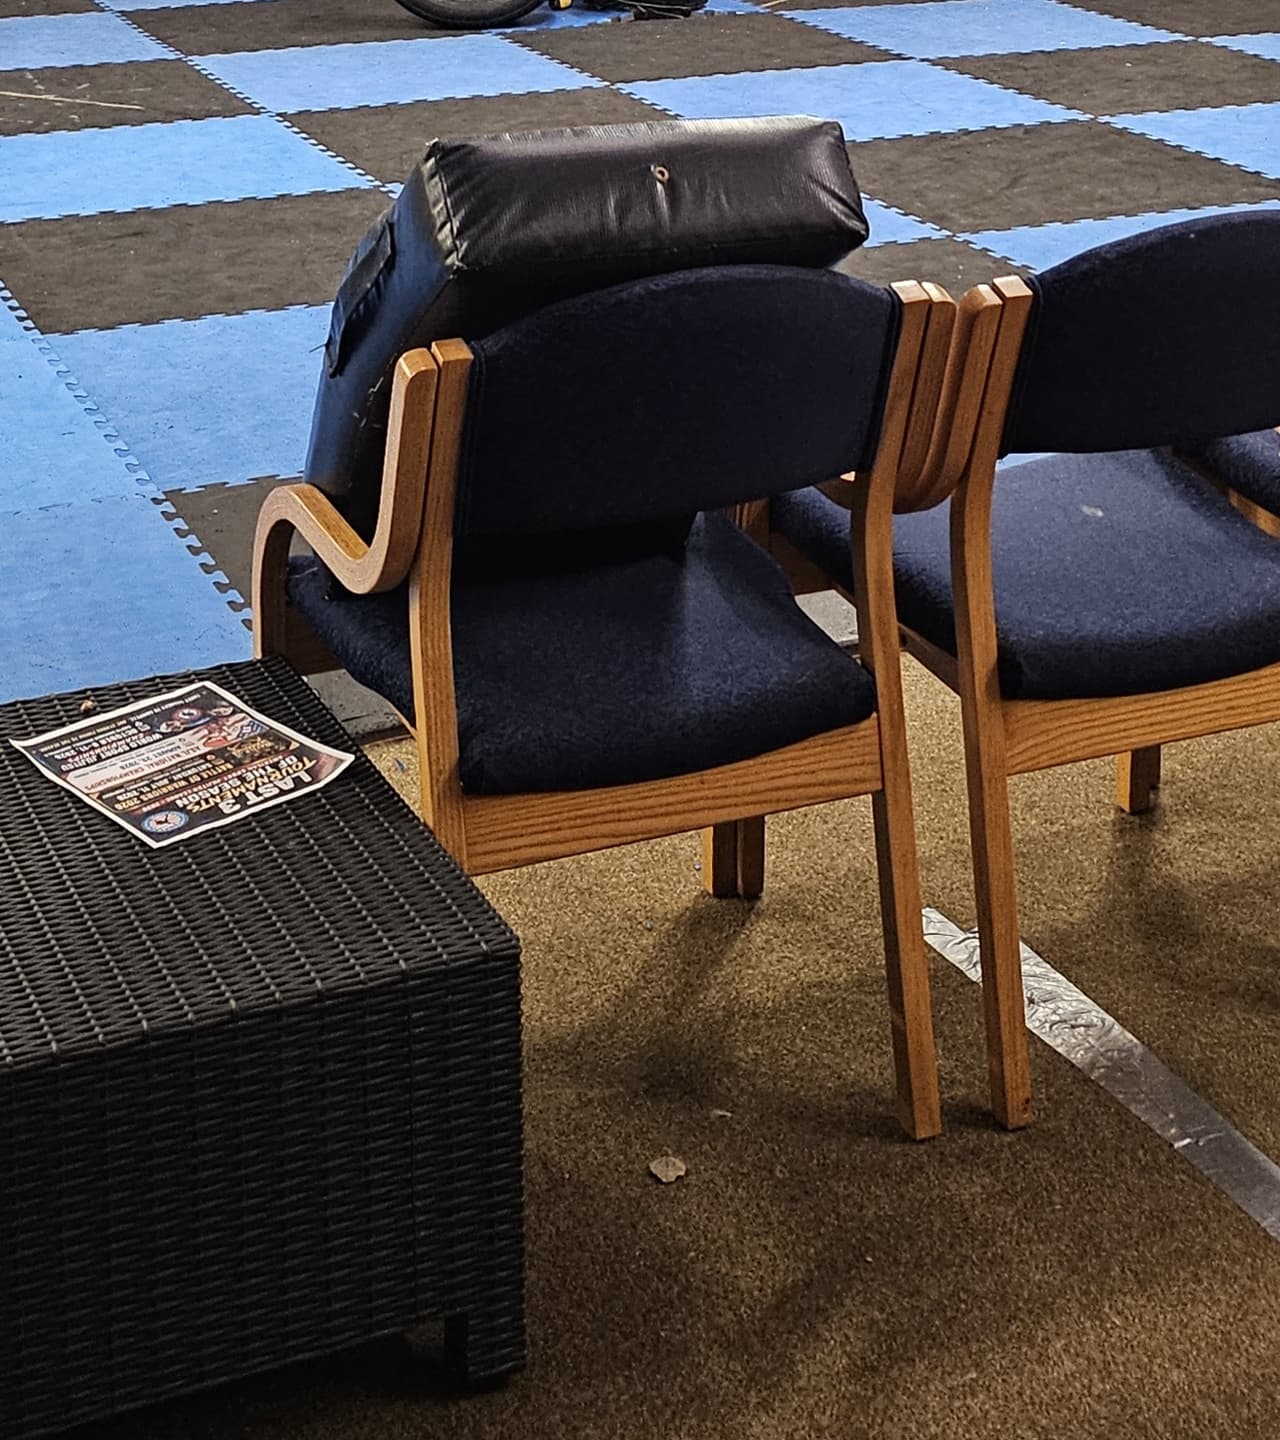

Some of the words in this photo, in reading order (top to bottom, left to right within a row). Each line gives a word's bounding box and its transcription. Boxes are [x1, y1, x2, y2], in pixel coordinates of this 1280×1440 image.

[64, 732, 146, 762] CHAMPIONSHIPS
[127, 732, 163, 747] WORLD
[97, 743, 130, 758] SPORT
[274, 754, 300, 769] OF
[198, 762, 234, 778] BATTLE
[241, 765, 274, 781] THE
[148, 778, 170, 789] JULY
[186, 774, 202, 783] OF
[186, 756, 318, 813] TOURNAMENTS
[137, 779, 188, 801] WARRIORS
[173, 777, 242, 807] SEASON
[247, 770, 312, 807] LAST
[219, 799, 241, 815] 3
